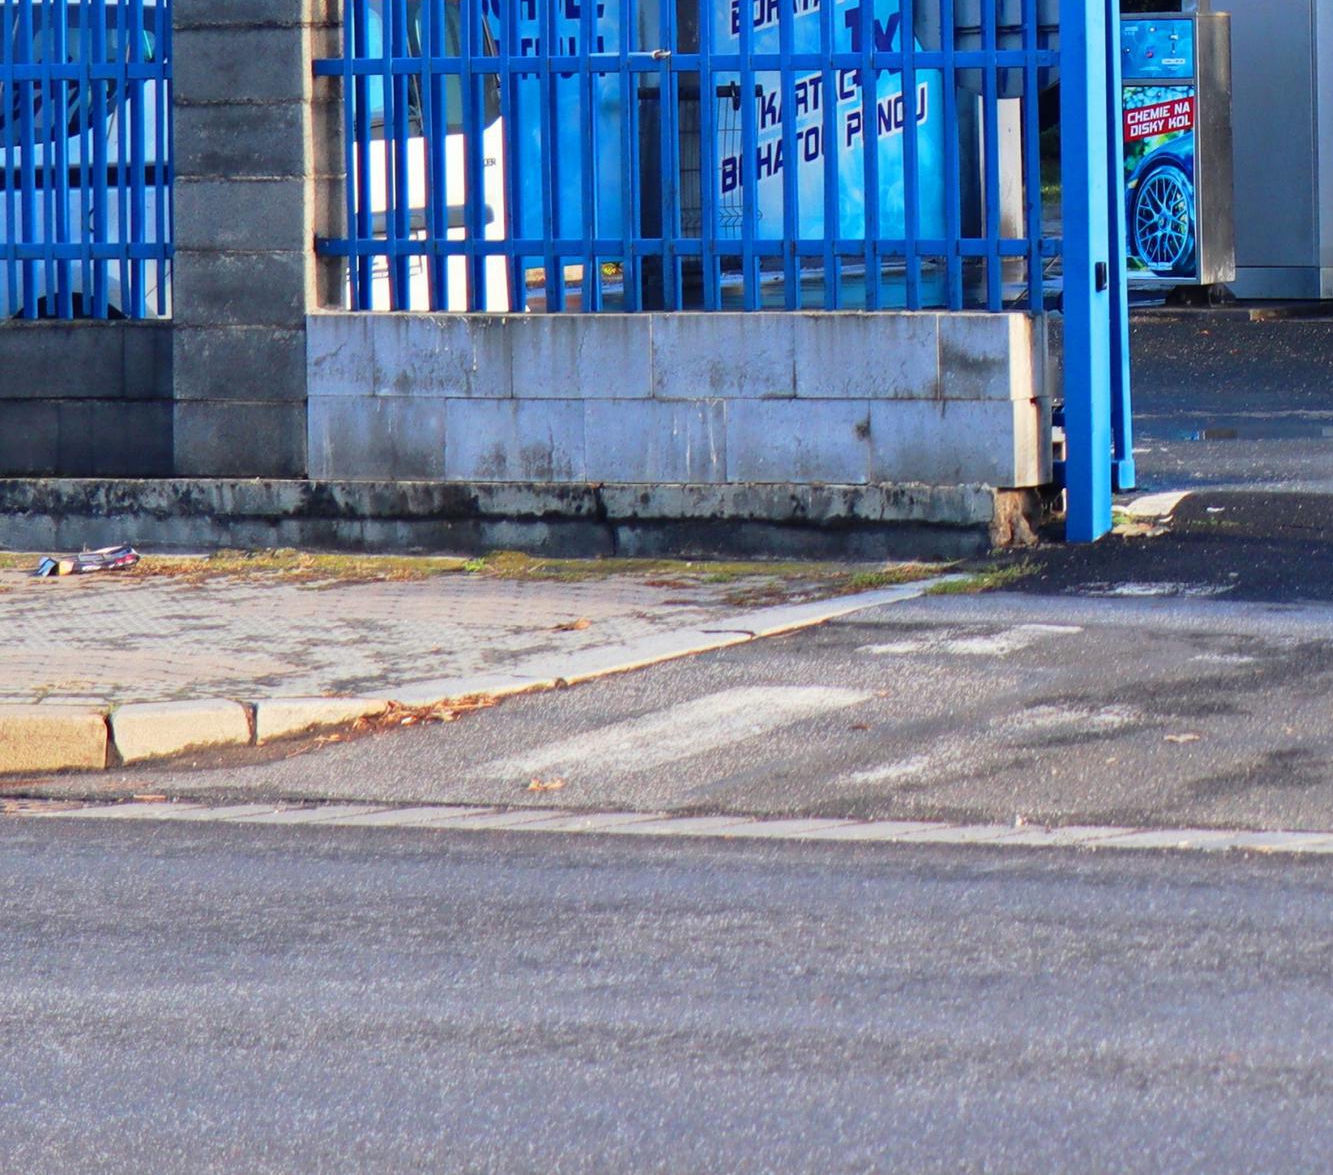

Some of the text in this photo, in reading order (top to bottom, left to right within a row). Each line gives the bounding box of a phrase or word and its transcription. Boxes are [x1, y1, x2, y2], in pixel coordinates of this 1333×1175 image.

[1127, 101, 1191, 124] CHEMIE NA
[1130, 114, 1192, 137] DISKY KOL
